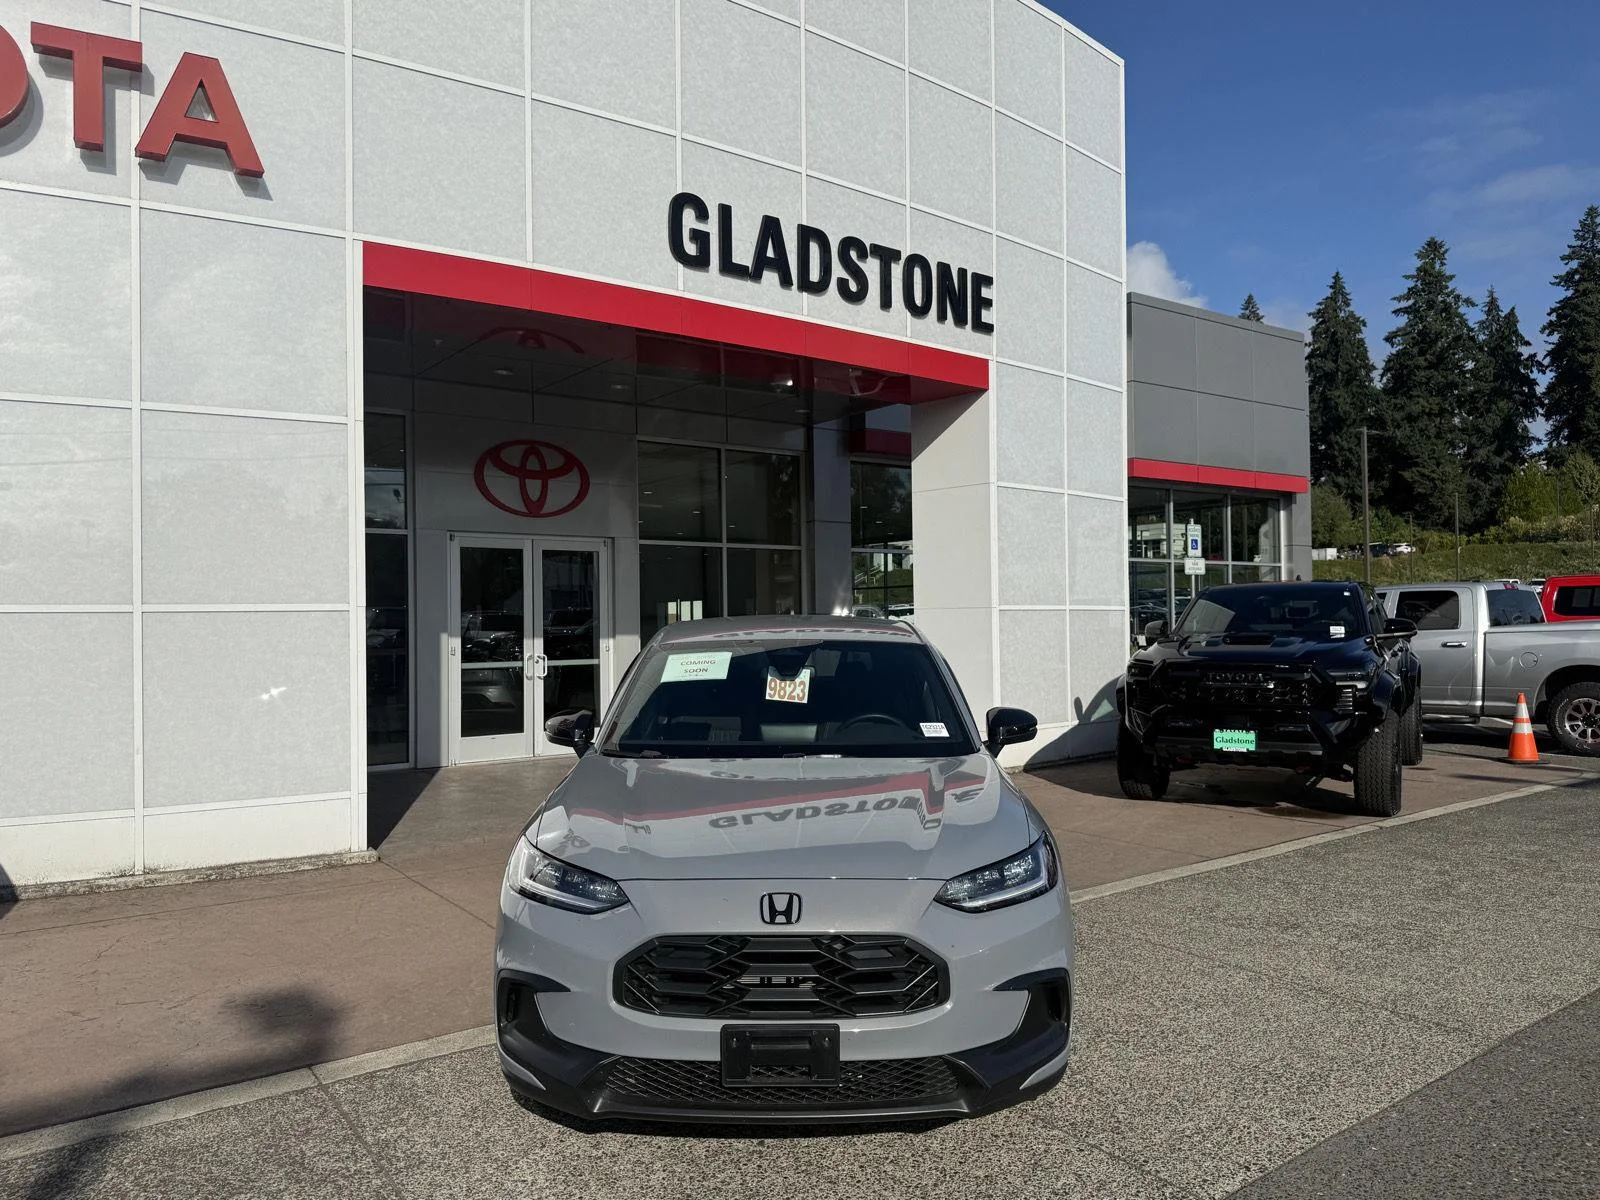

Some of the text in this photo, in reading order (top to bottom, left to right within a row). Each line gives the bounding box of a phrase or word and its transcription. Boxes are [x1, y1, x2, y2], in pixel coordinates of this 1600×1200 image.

[0, 21, 265, 178] TA
[668, 192, 994, 333] GLADSTONE
[768, 677, 806, 701] 9823
[1215, 736, 1255, 745] Gladstone
